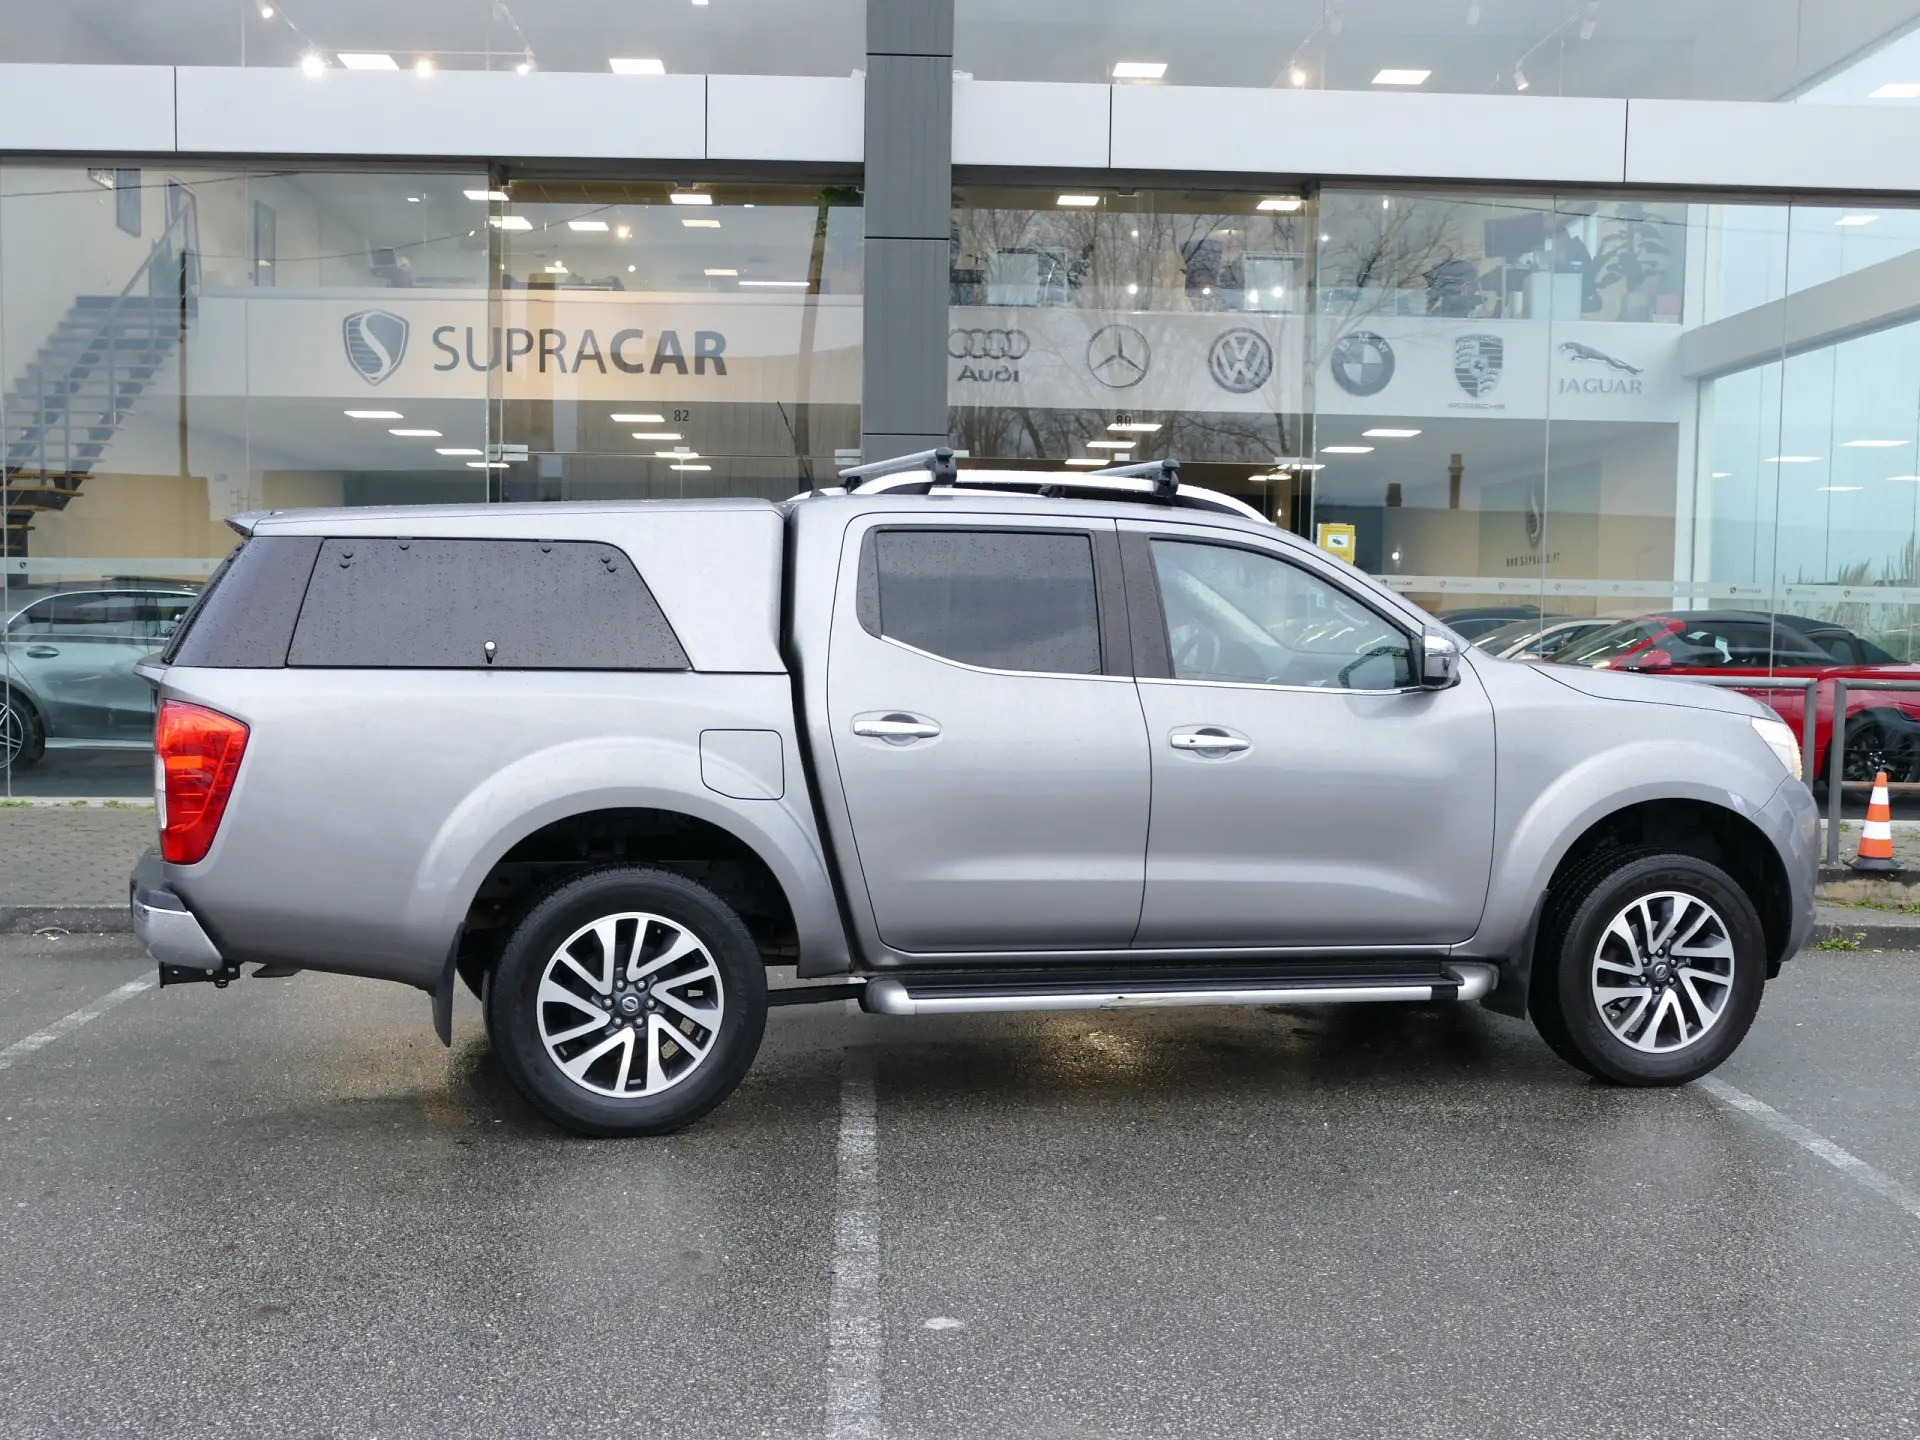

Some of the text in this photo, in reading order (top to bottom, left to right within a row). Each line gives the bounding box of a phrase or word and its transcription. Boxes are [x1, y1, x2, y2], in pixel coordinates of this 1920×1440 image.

[432, 325, 727, 376] SUPRACAR
[1557, 377, 1643, 395] JAGUAR
[673, 409, 690, 422] 82
[1116, 414, 1132, 427] 80
